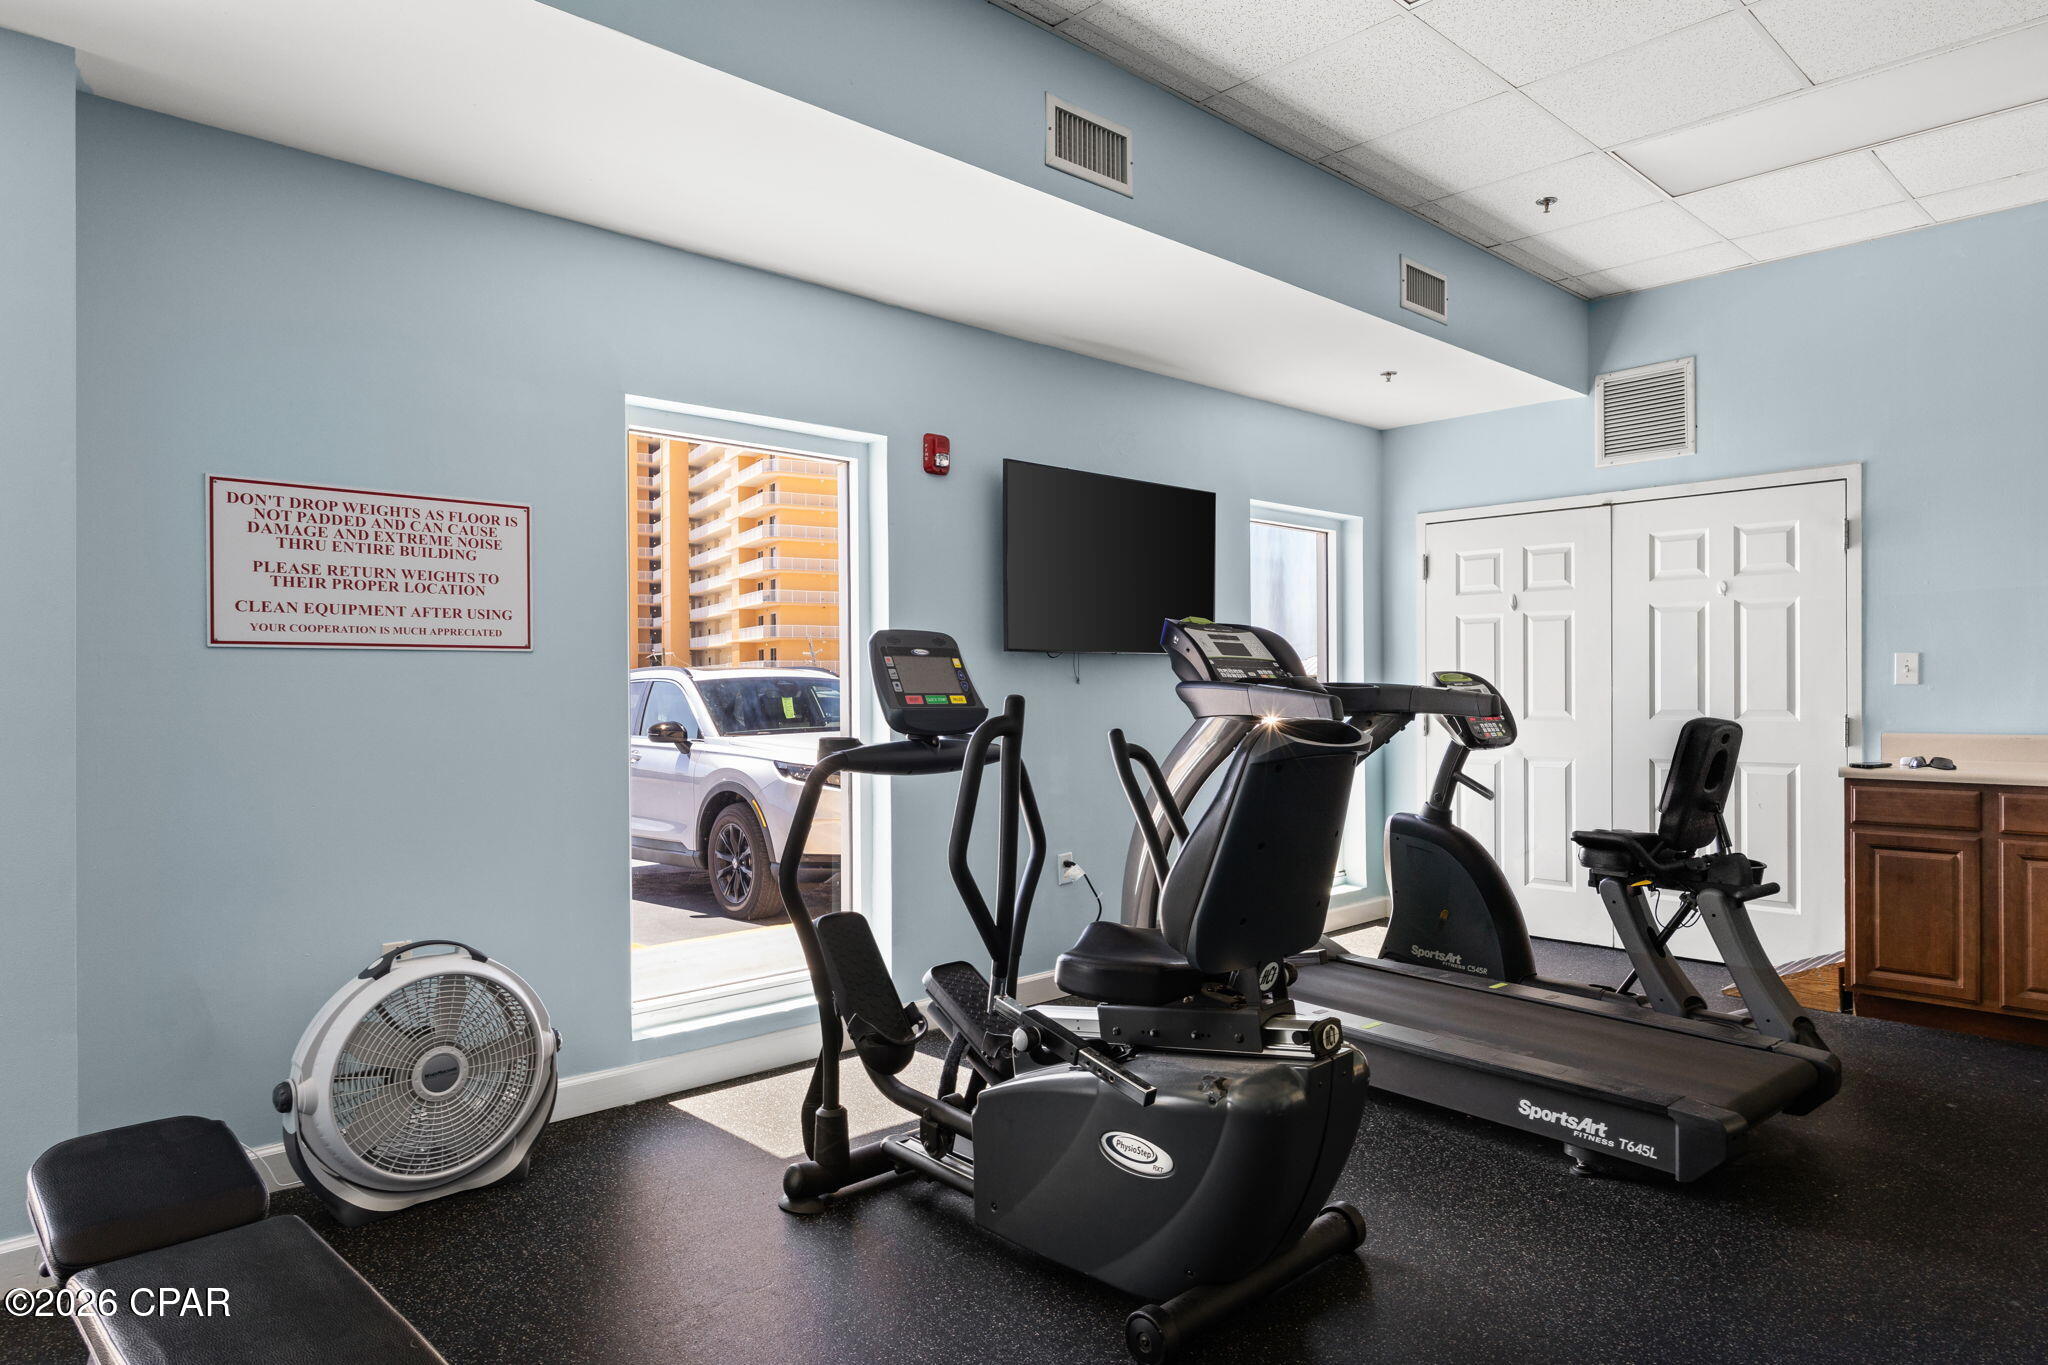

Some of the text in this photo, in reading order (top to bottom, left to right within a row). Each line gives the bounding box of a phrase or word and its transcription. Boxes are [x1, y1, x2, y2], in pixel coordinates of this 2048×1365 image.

[226, 491, 518, 528] DON'T DROP WEIGHTS AS FLOOR IS
[254, 507, 498, 538] NOT PADDED AND CAN CAUSE
[247, 520, 503, 551] DAMAGE AND EXTREME NOISE
[276, 536, 478, 562] THRU ENTIRE BUILDING
[253, 560, 500, 585] PLEASE RETURN WEIGHTS TO
[270, 575, 486, 596] THEIR PROPER LOCATION
[234, 599, 513, 621] CLEAN EQUIPMENT AFTER USING
[249, 622, 503, 638] YOUR COOPERATION IS MUCH APPRECIATED
[1410, 944, 1462, 964] SportsArt
[1442, 961, 1466, 970] FITNESS
[1518, 1099, 1608, 1137] SportsArt
[1116, 1139, 1152, 1160] PhysioStep
[1573, 1130, 1658, 1160] FITNESS T645L
